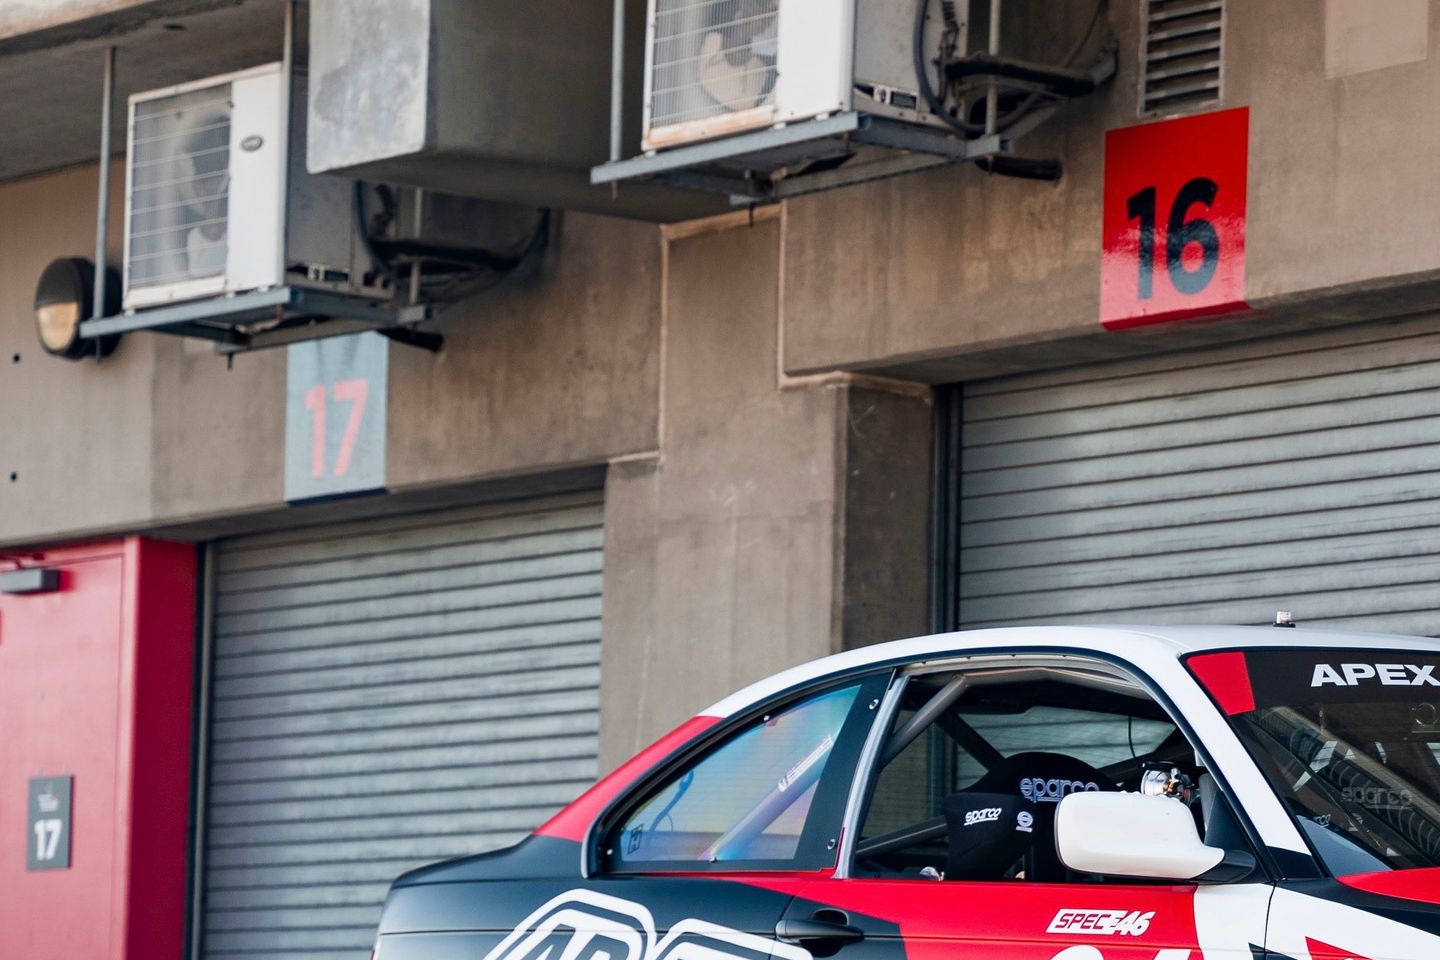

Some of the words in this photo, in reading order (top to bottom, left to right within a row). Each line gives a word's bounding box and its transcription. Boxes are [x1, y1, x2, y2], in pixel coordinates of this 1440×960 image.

[1126, 176, 1219, 300] 16
[304, 378, 369, 478] 17
[1019, 777, 1100, 803] sparco
[964, 807, 1002, 826] sparco
[34, 818, 62, 861] 17
